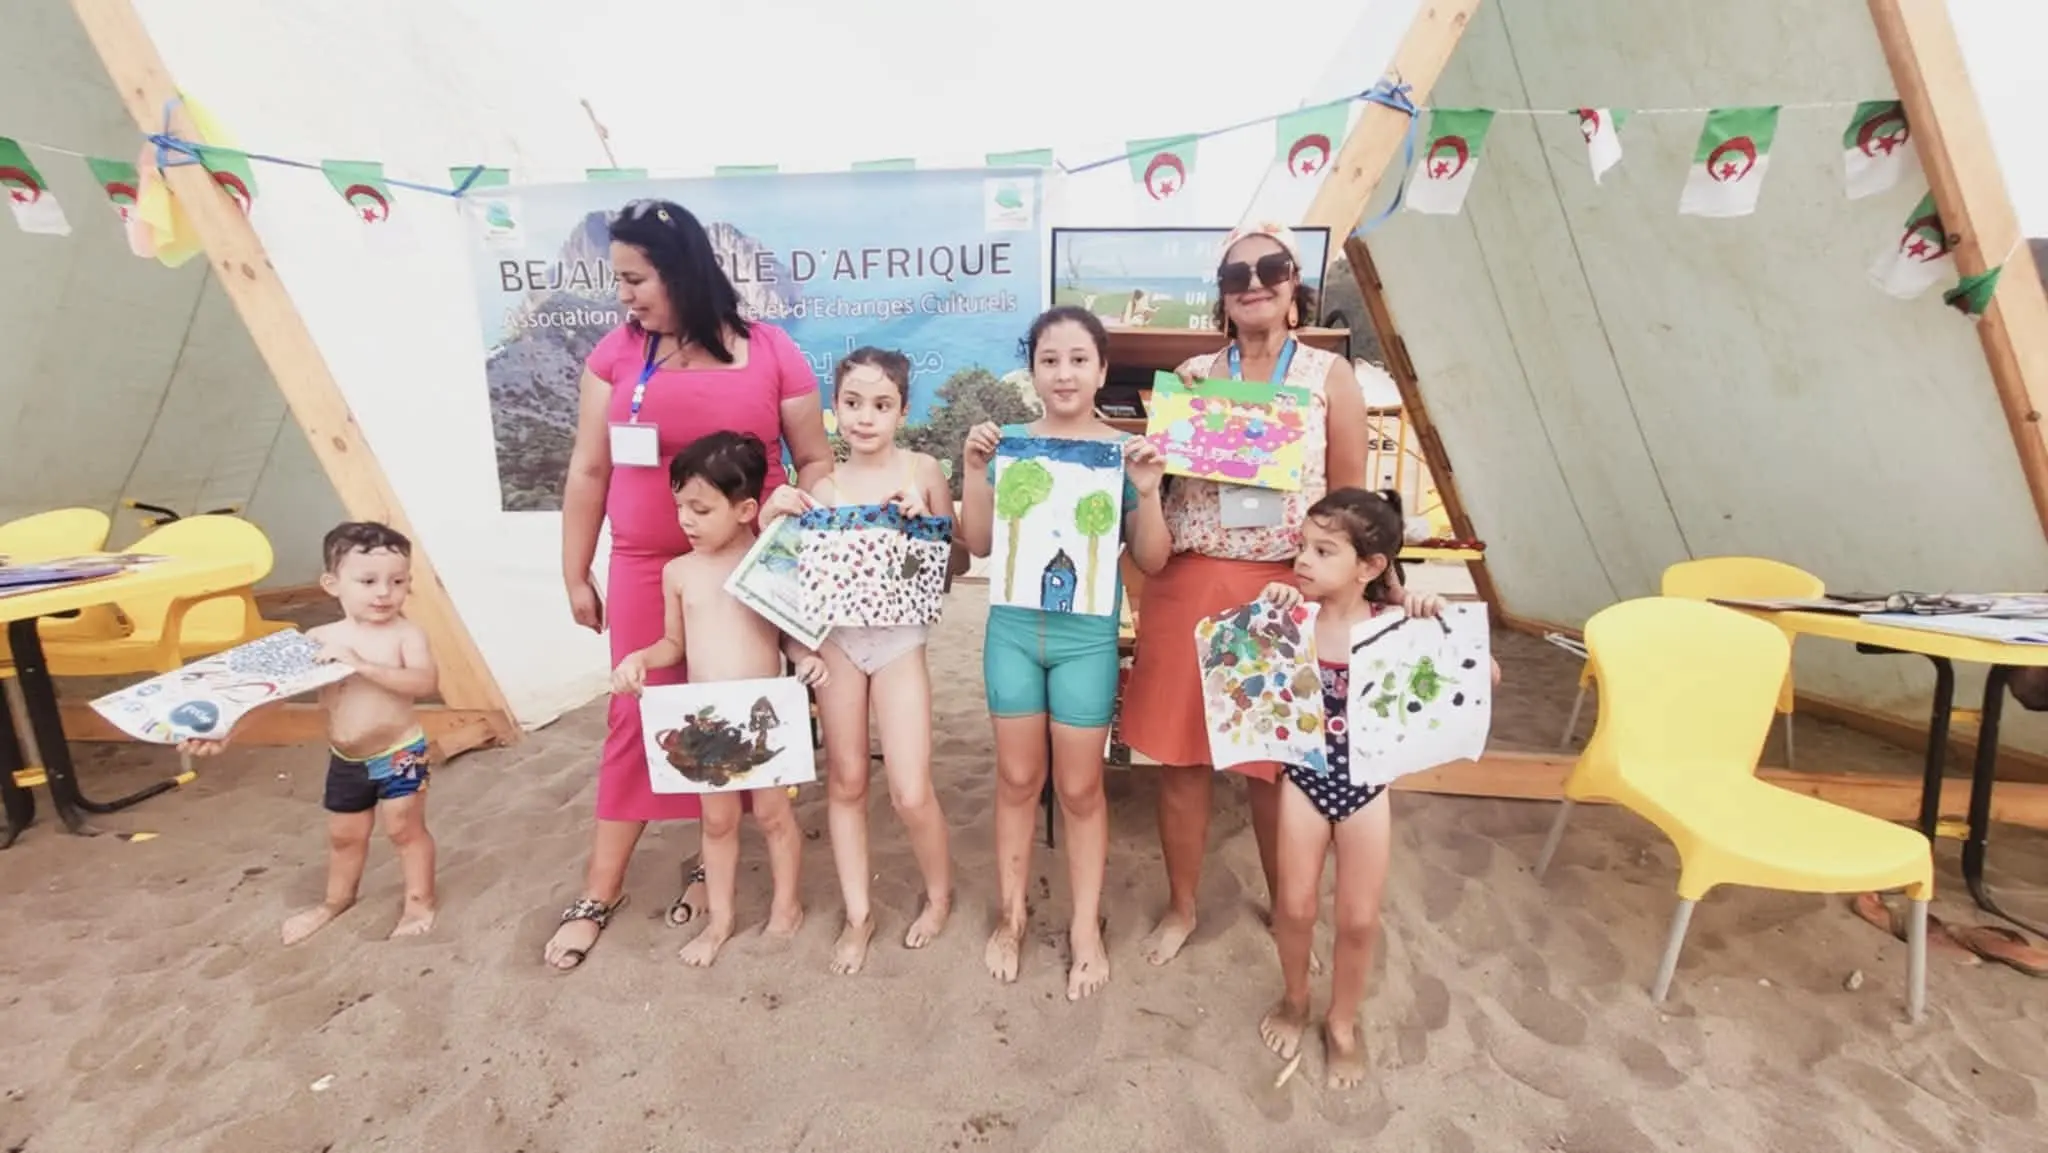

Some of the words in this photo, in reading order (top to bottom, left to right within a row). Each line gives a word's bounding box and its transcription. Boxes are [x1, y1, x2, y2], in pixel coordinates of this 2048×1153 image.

[791, 242, 1012, 283] D'AFRIQUE
[503, 305, 618, 328] Association
[920, 289, 1018, 315] Culturels
